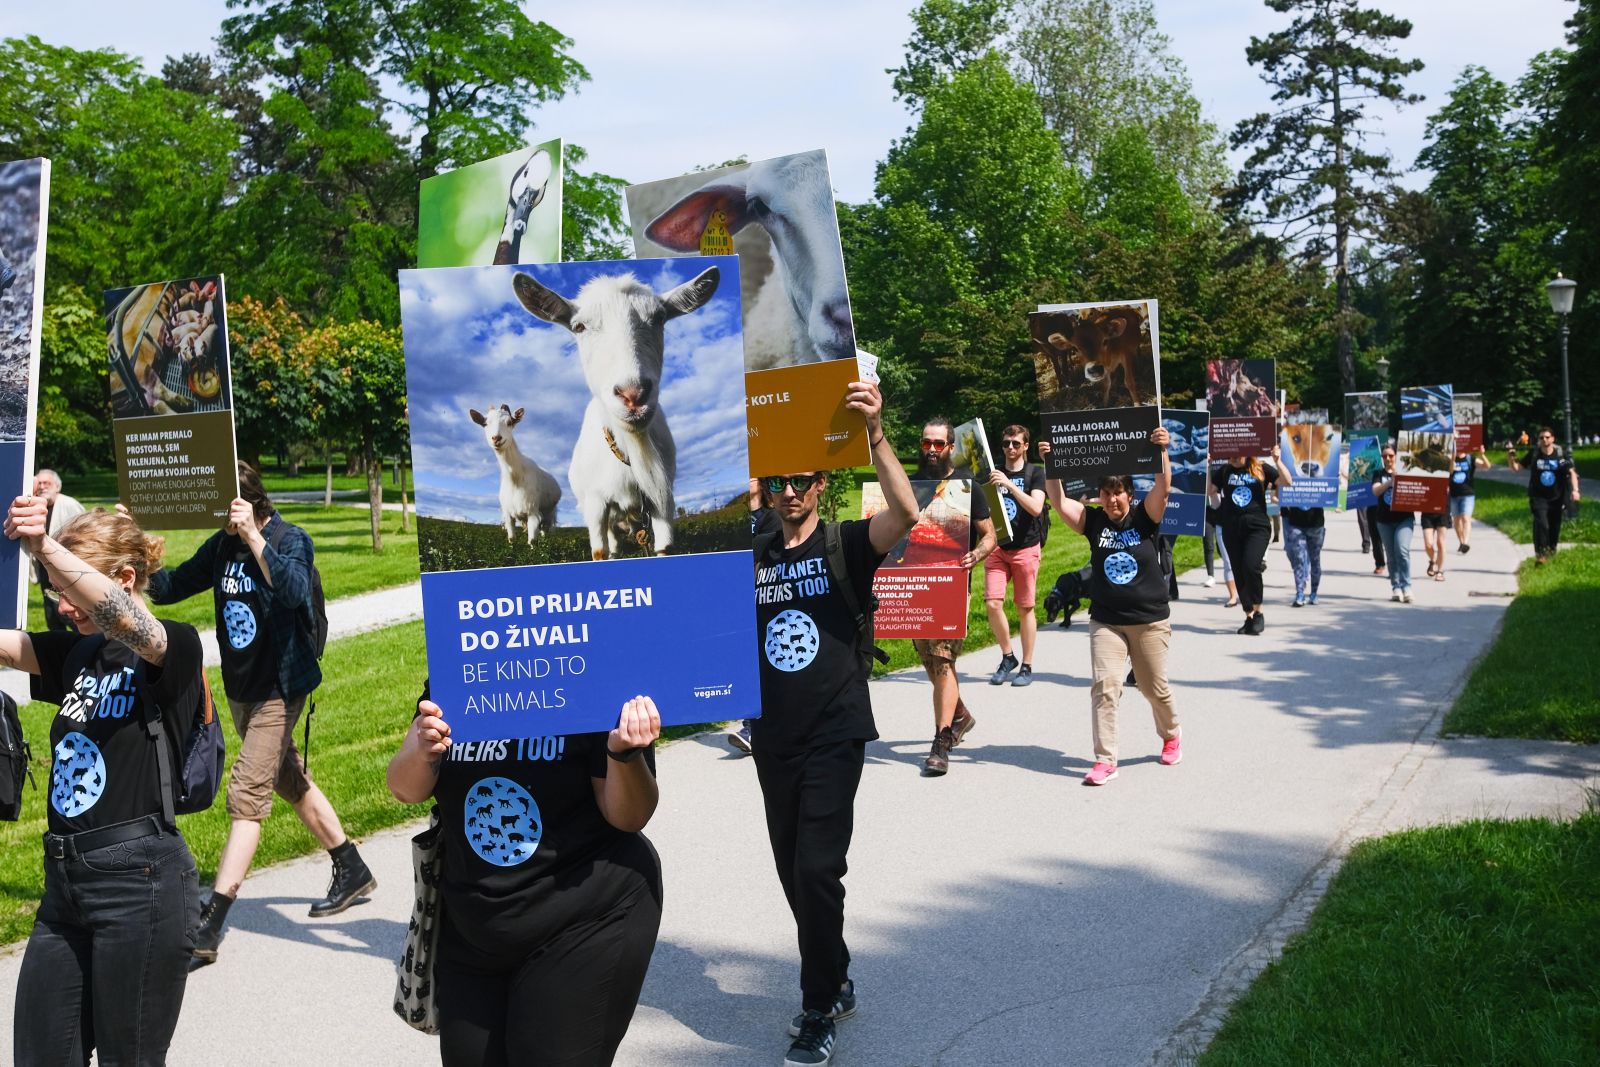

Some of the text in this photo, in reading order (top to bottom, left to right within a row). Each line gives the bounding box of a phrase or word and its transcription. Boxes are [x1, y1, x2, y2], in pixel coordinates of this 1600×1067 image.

[752, 394, 774, 406] KOT
[776, 392, 790, 402] LE
[1052, 421, 1119, 433] ZAKAJ MORAM
[126, 430, 192, 442] KER IMAM PREMALO
[824, 432, 848, 442] vegan.si
[1052, 431, 1147, 444] UMRETI TAKO MLAD?
[127, 443, 180, 454] PROSTORA, SEM
[1053, 448, 1072, 456] WHY
[1074, 447, 1086, 455] DO
[1093, 445, 1114, 453] HAVE
[1116, 444, 1126, 452] TO
[127, 456, 167, 466] VKLENJENA,
[1054, 456, 1110, 467] DIE SO SOON?
[129, 466, 215, 478] POTEPTAM SVOJIH OTROK
[132, 481, 151, 490] DON'T
[152, 480, 167, 489] HAVE
[169, 479, 195, 488] ENOUGH
[197, 478, 215, 487] SPACE
[130, 491, 219, 503] SO THEY LOCK ME IN TO AVOID
[131, 505, 164, 514] TRAMPLING
[176, 504, 206, 513] CHILDREN
[756, 558, 826, 585] OUR PLANET,
[755, 576, 830, 604] THEIRS TOO!
[458, 587, 652, 620] BODI PRIJAZEN
[460, 624, 589, 652] DO ŽIVALI
[463, 655, 585, 684] BE KIND TO
[694, 688, 731, 698] vegan.si
[465, 688, 566, 715] ANIMALS
[447, 736, 565, 762] HEIRS TOO!
